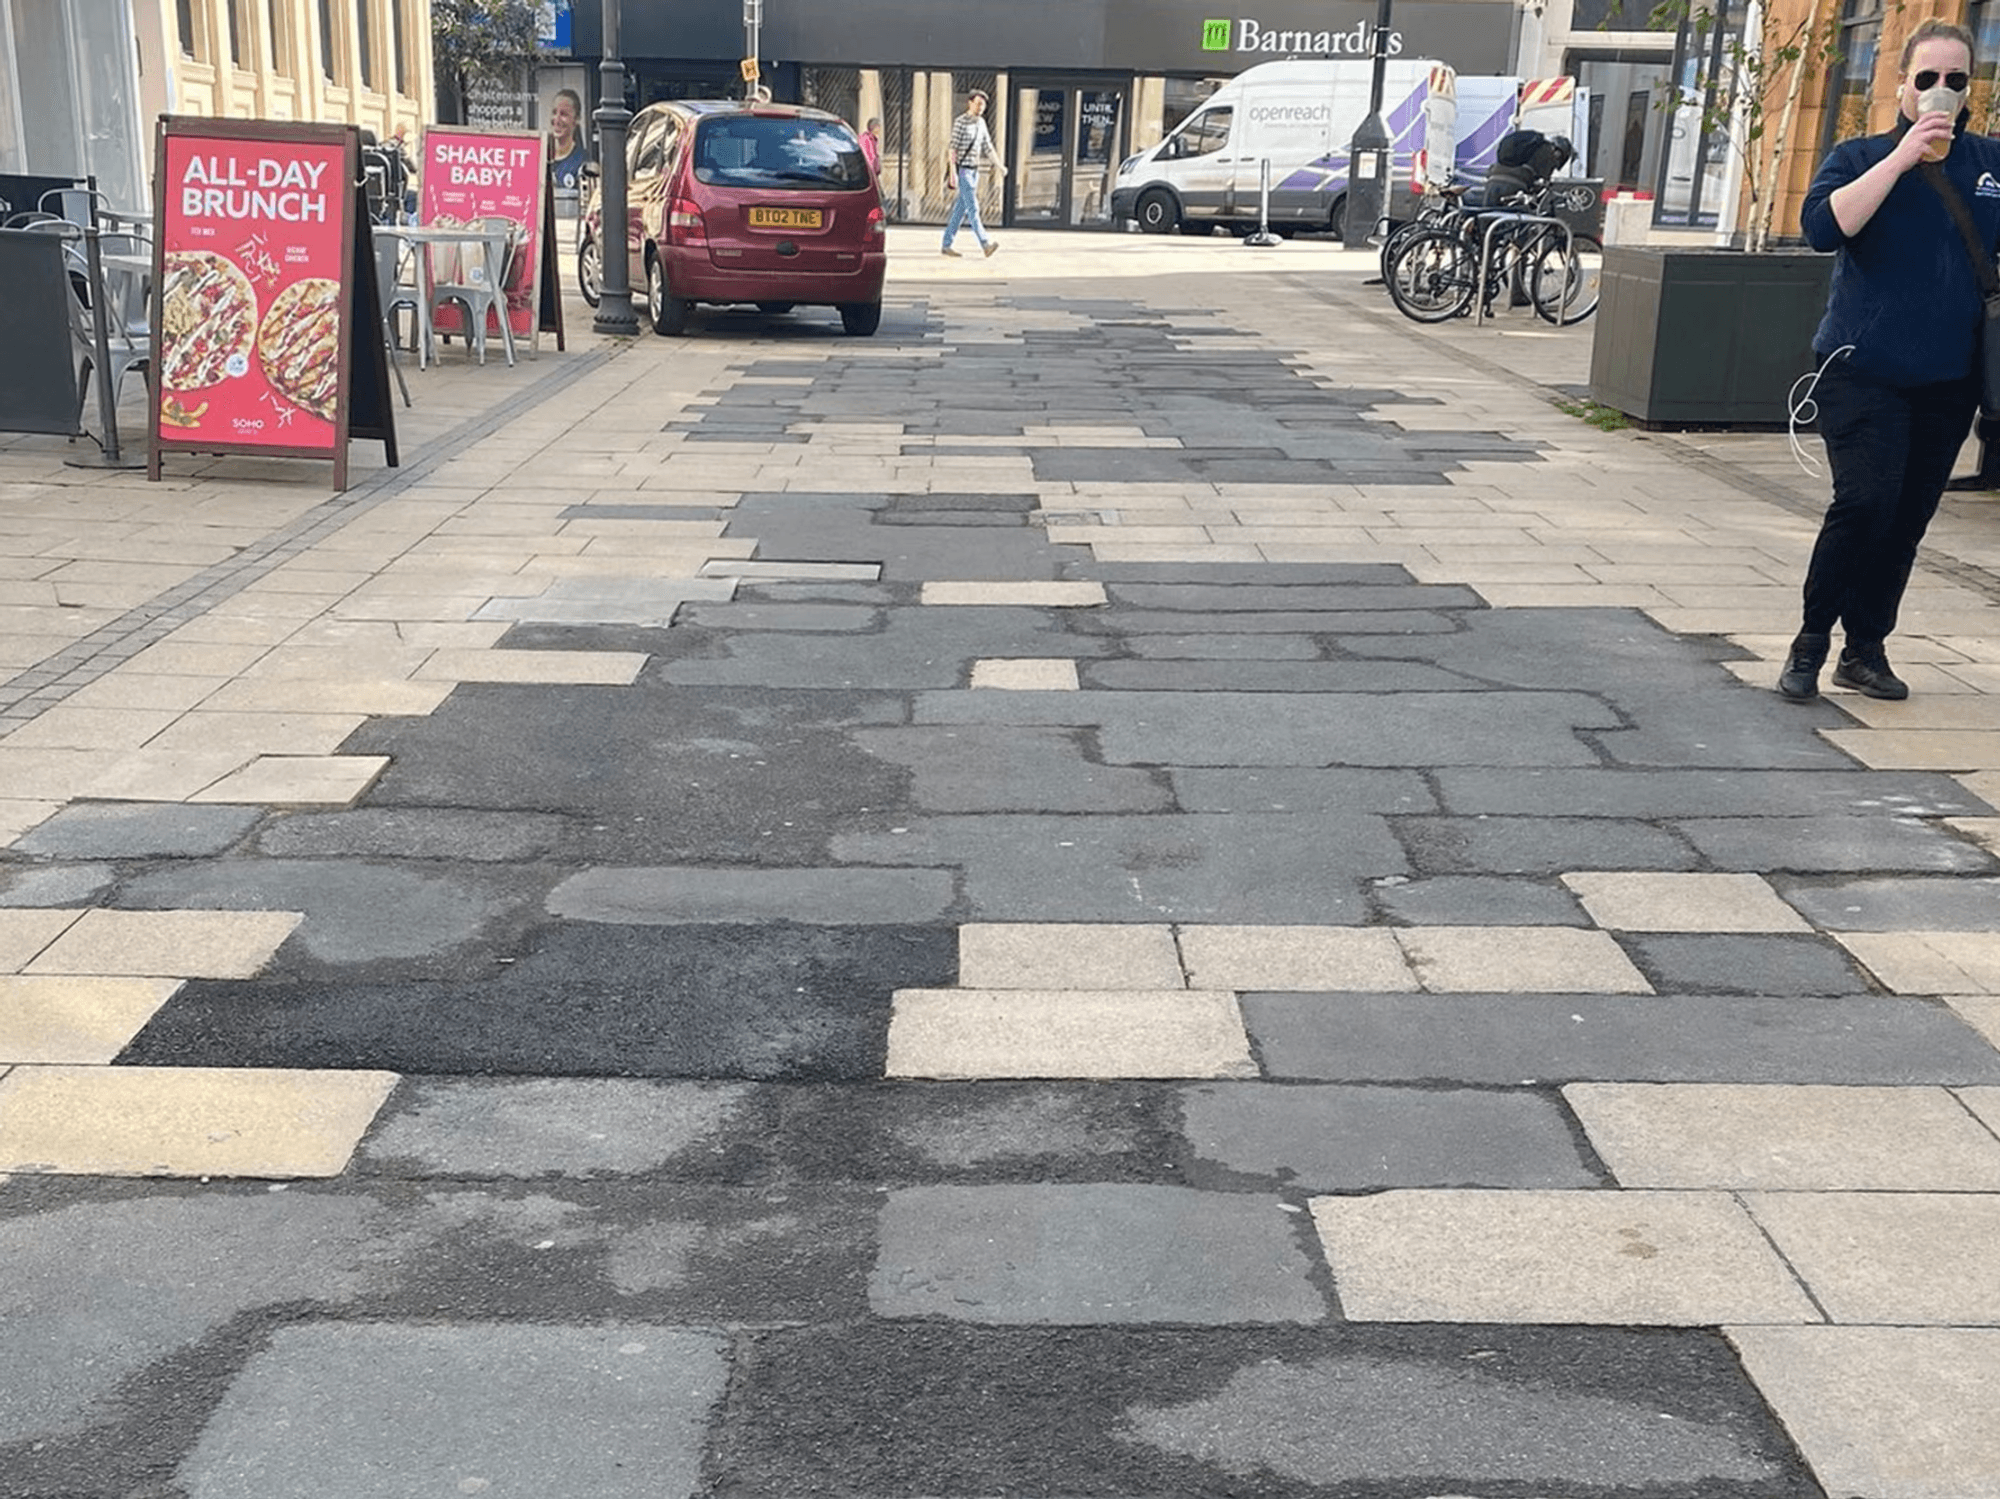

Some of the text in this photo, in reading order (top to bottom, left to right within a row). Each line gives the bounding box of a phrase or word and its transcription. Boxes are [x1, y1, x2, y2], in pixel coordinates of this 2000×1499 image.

[1236, 19, 1403, 55] Barnards
[1083, 103, 1114, 113] UNTIL
[1249, 104, 1331, 122] openreach
[435, 144, 532, 168] SHAKE IT
[182, 155, 328, 190] ALL-DAY
[450, 165, 513, 188] BABY!
[182, 186, 326, 222] BRUNCH
[232, 418, 265, 429] SOHO
